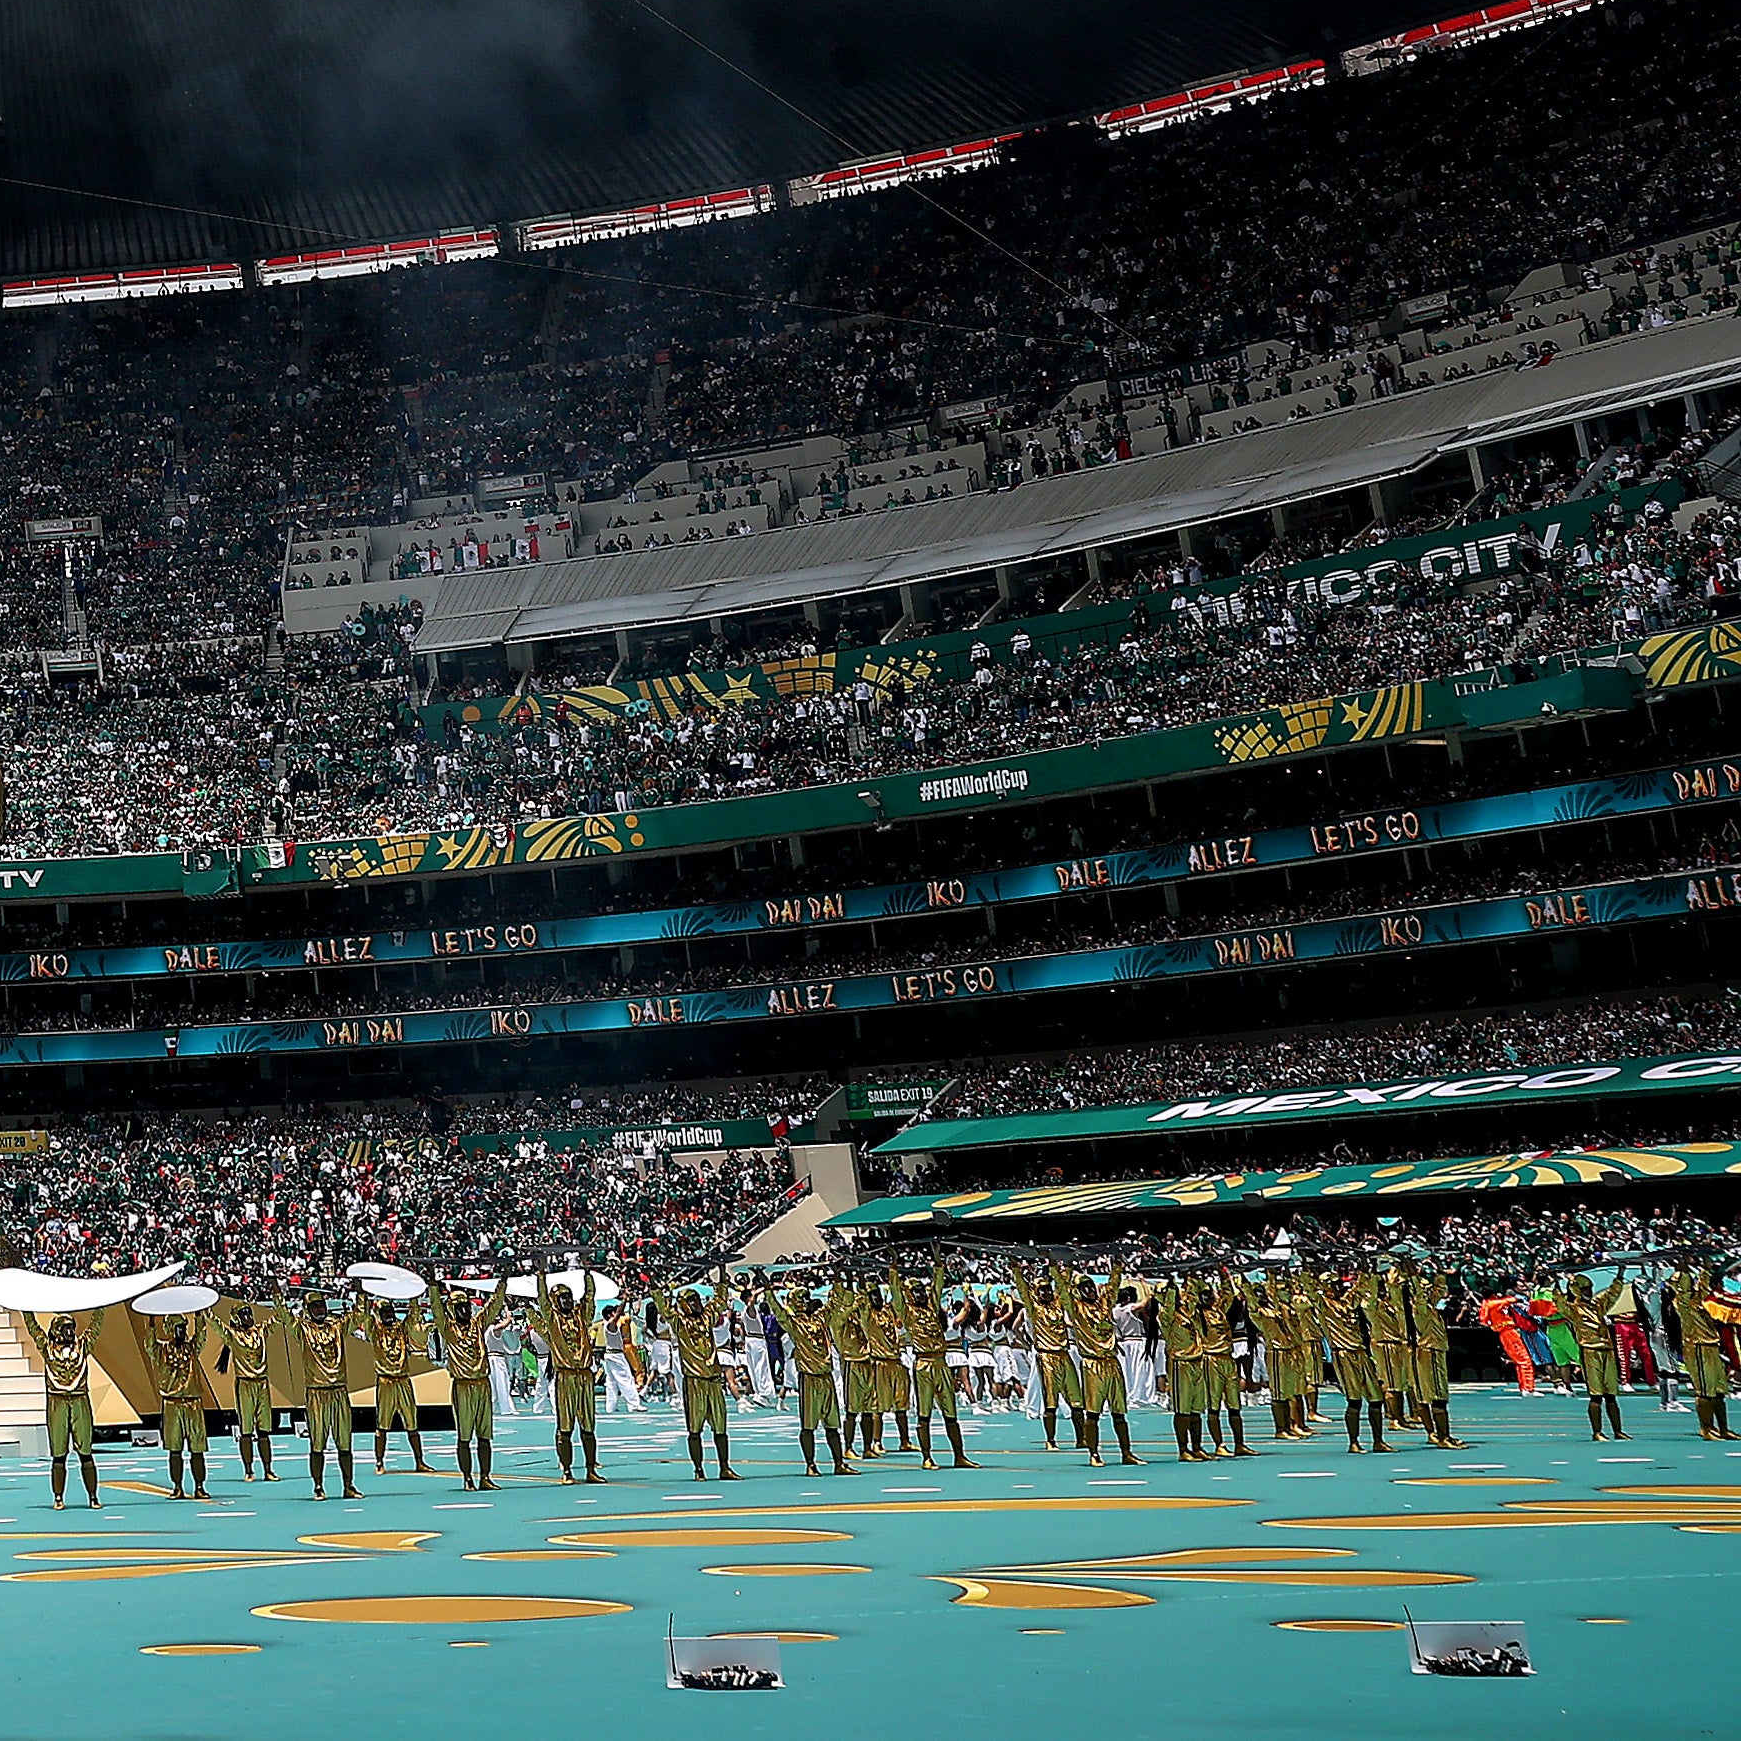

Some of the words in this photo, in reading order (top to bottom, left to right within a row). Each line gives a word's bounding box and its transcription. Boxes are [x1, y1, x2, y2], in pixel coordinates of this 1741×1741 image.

[82, 651, 96, 661] 20
[919, 769, 1028, 802] #FIFAWorldCup
[1674, 769, 1716, 800] DAI
[1311, 818, 1378, 853] LET'S
[1385, 812, 1418, 841] GO
[1188, 838, 1257, 872] ALLEZ
[1056, 860, 1110, 890] DALE
[926, 880, 965, 907] IKO
[766, 900, 801, 924] DAI
[808, 894, 843, 919] DAI
[1527, 894, 1589, 930] DALE
[431, 926, 497, 956] LET'S
[504, 924, 537, 948] GO
[1380, 915, 1422, 946] IKO
[166, 947, 220, 971] DALE
[303, 936, 374, 964] ALLEZ
[1215, 938, 1251, 967] DAI
[1258, 931, 1294, 961] DAI
[29, 954, 69, 977] IKO
[893, 971, 957, 1001] LET'S
[964, 966, 994, 993] GO
[628, 998, 684, 1025] DALE
[767, 985, 837, 1014] ALLEZ
[324, 1020, 359, 1045] DAI
[367, 1018, 403, 1042] DAI
[490, 1009, 531, 1034] IKO
[867, 1089, 899, 1104] SALIDA
[900, 1088, 919, 1102] EXIT
[921, 1086, 932, 1100] 19
[1147, 1066, 1621, 1122] MEXICO
